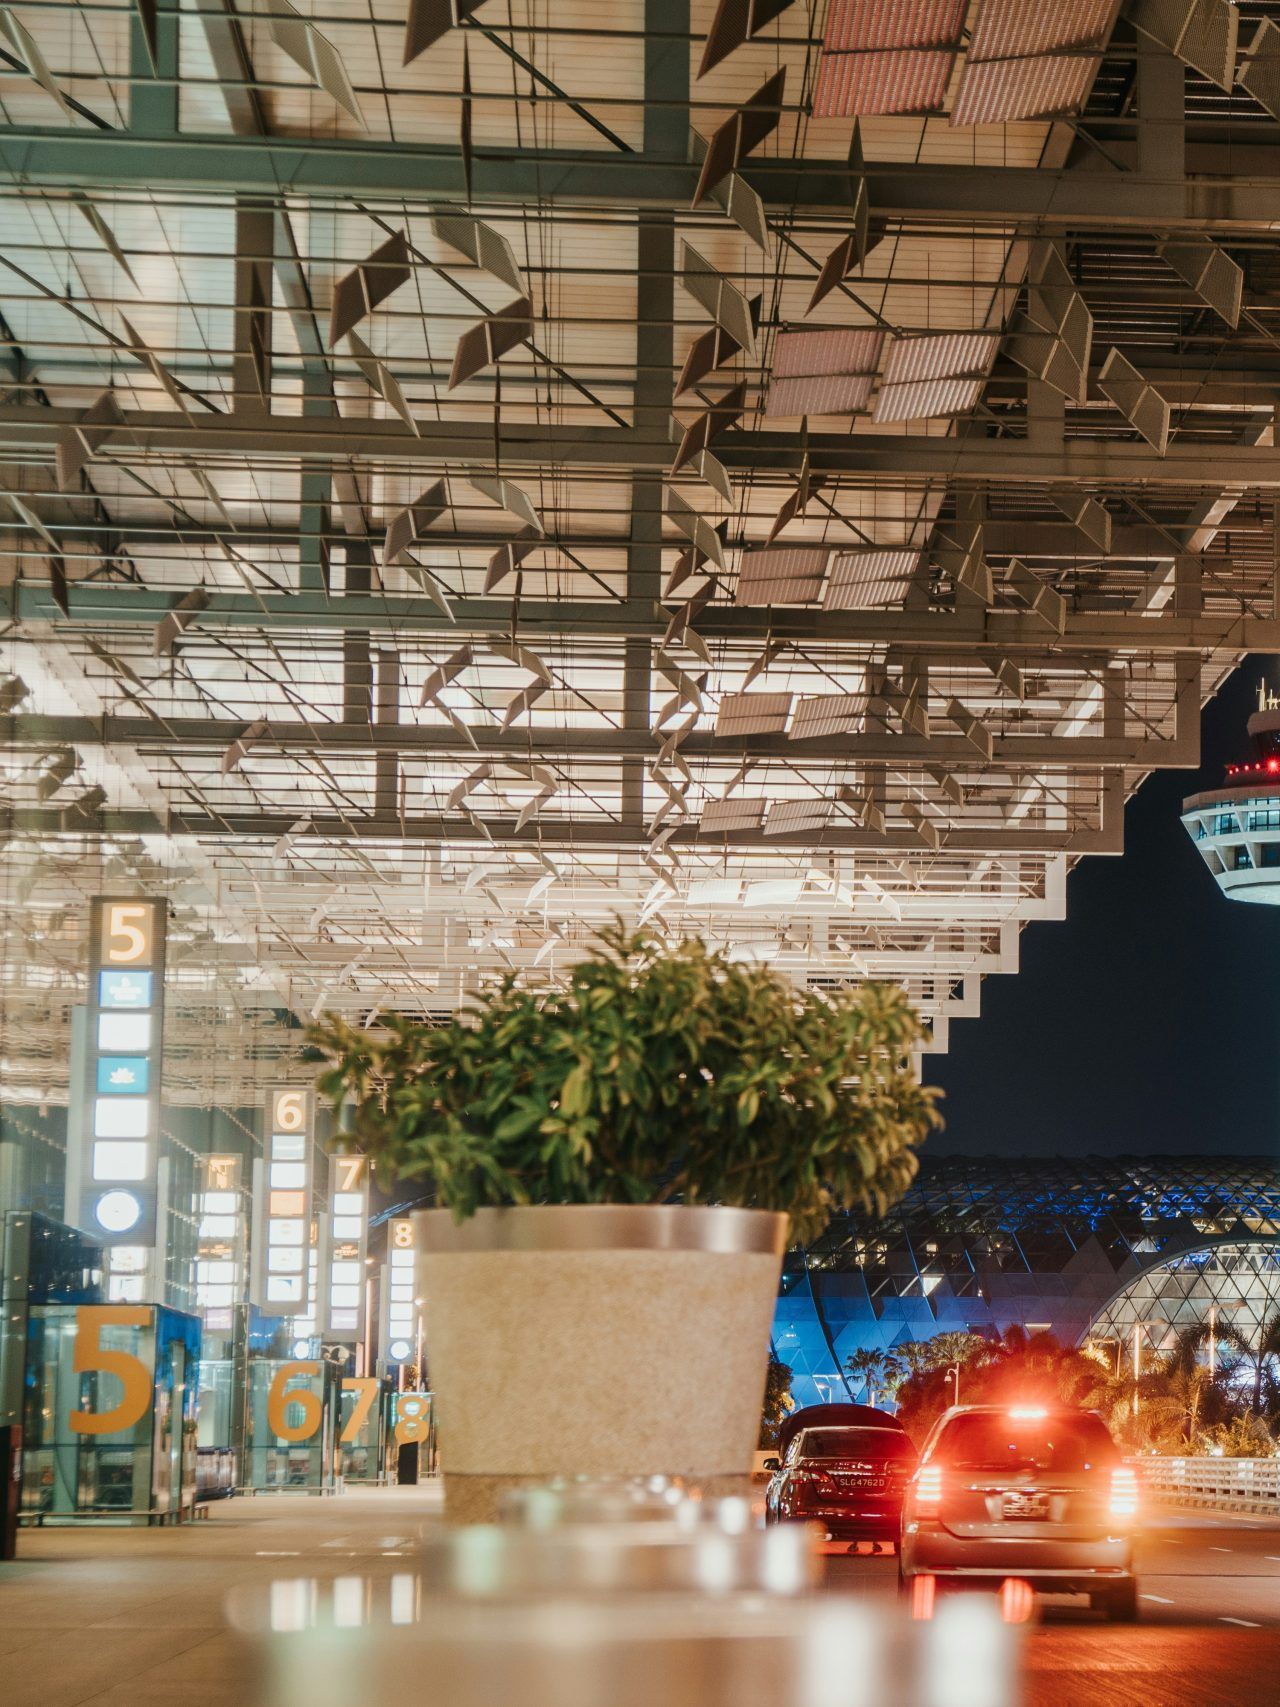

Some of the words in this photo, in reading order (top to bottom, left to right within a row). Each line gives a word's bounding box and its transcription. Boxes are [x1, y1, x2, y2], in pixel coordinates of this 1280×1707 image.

[110, 906, 146, 962] 5
[276, 1093, 303, 1130] 6
[338, 1160, 364, 1191] 7
[394, 1222, 413, 1247] 8
[69, 1305, 152, 1435] 5
[268, 1361, 322, 1442] 6
[340, 1377, 378, 1442] 7
[395, 1395, 430, 1446] 8
